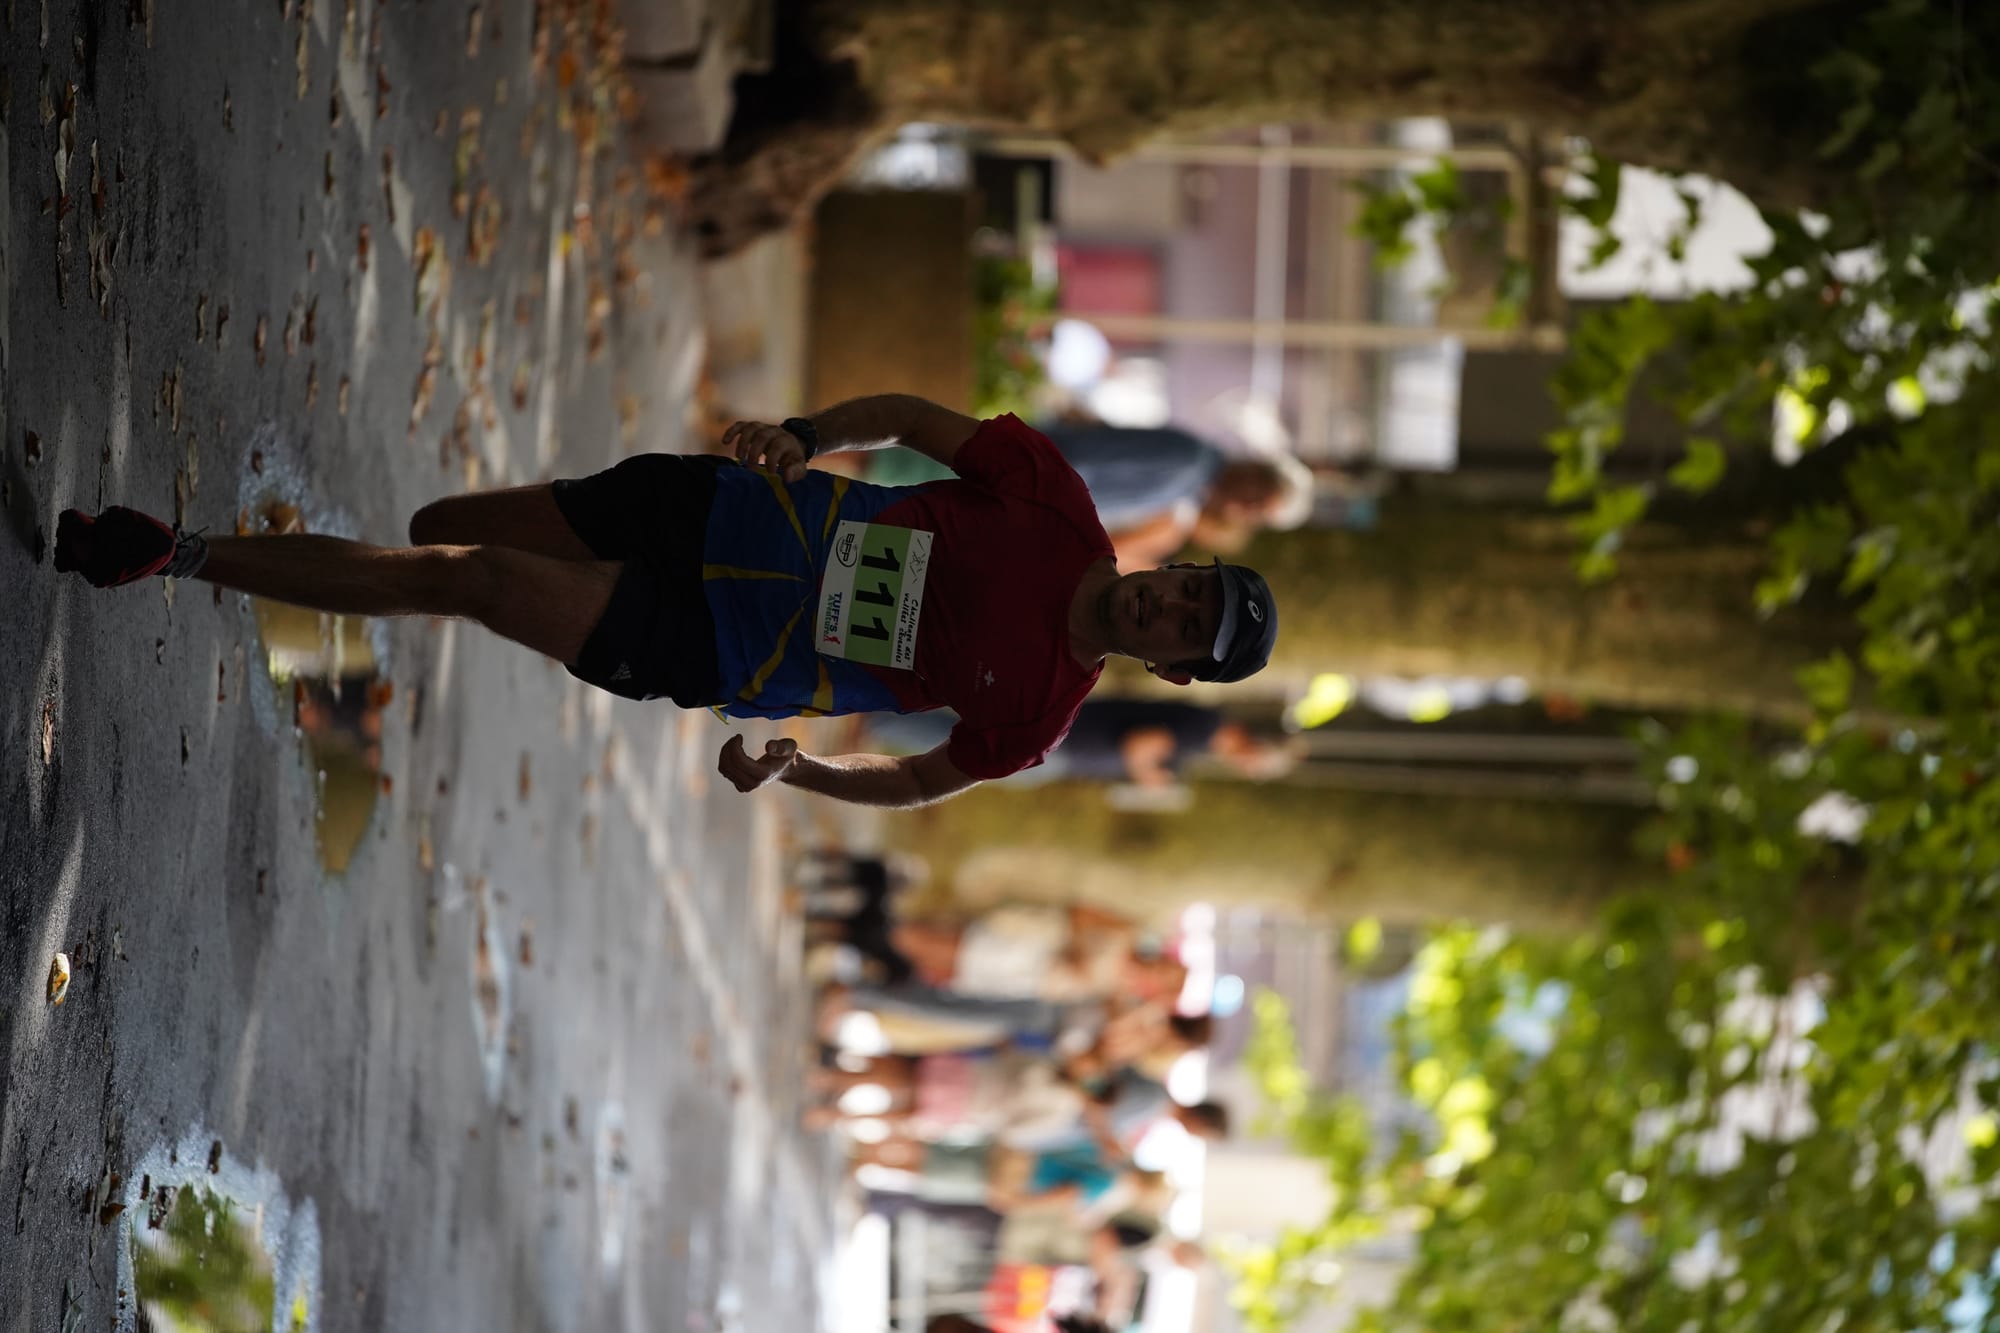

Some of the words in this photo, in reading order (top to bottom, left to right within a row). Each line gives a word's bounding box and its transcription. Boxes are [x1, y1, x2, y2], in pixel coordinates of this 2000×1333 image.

[830, 592, 842, 632] TUFF'S
[850, 547, 900, 641] 111
[904, 646, 912, 660] des
